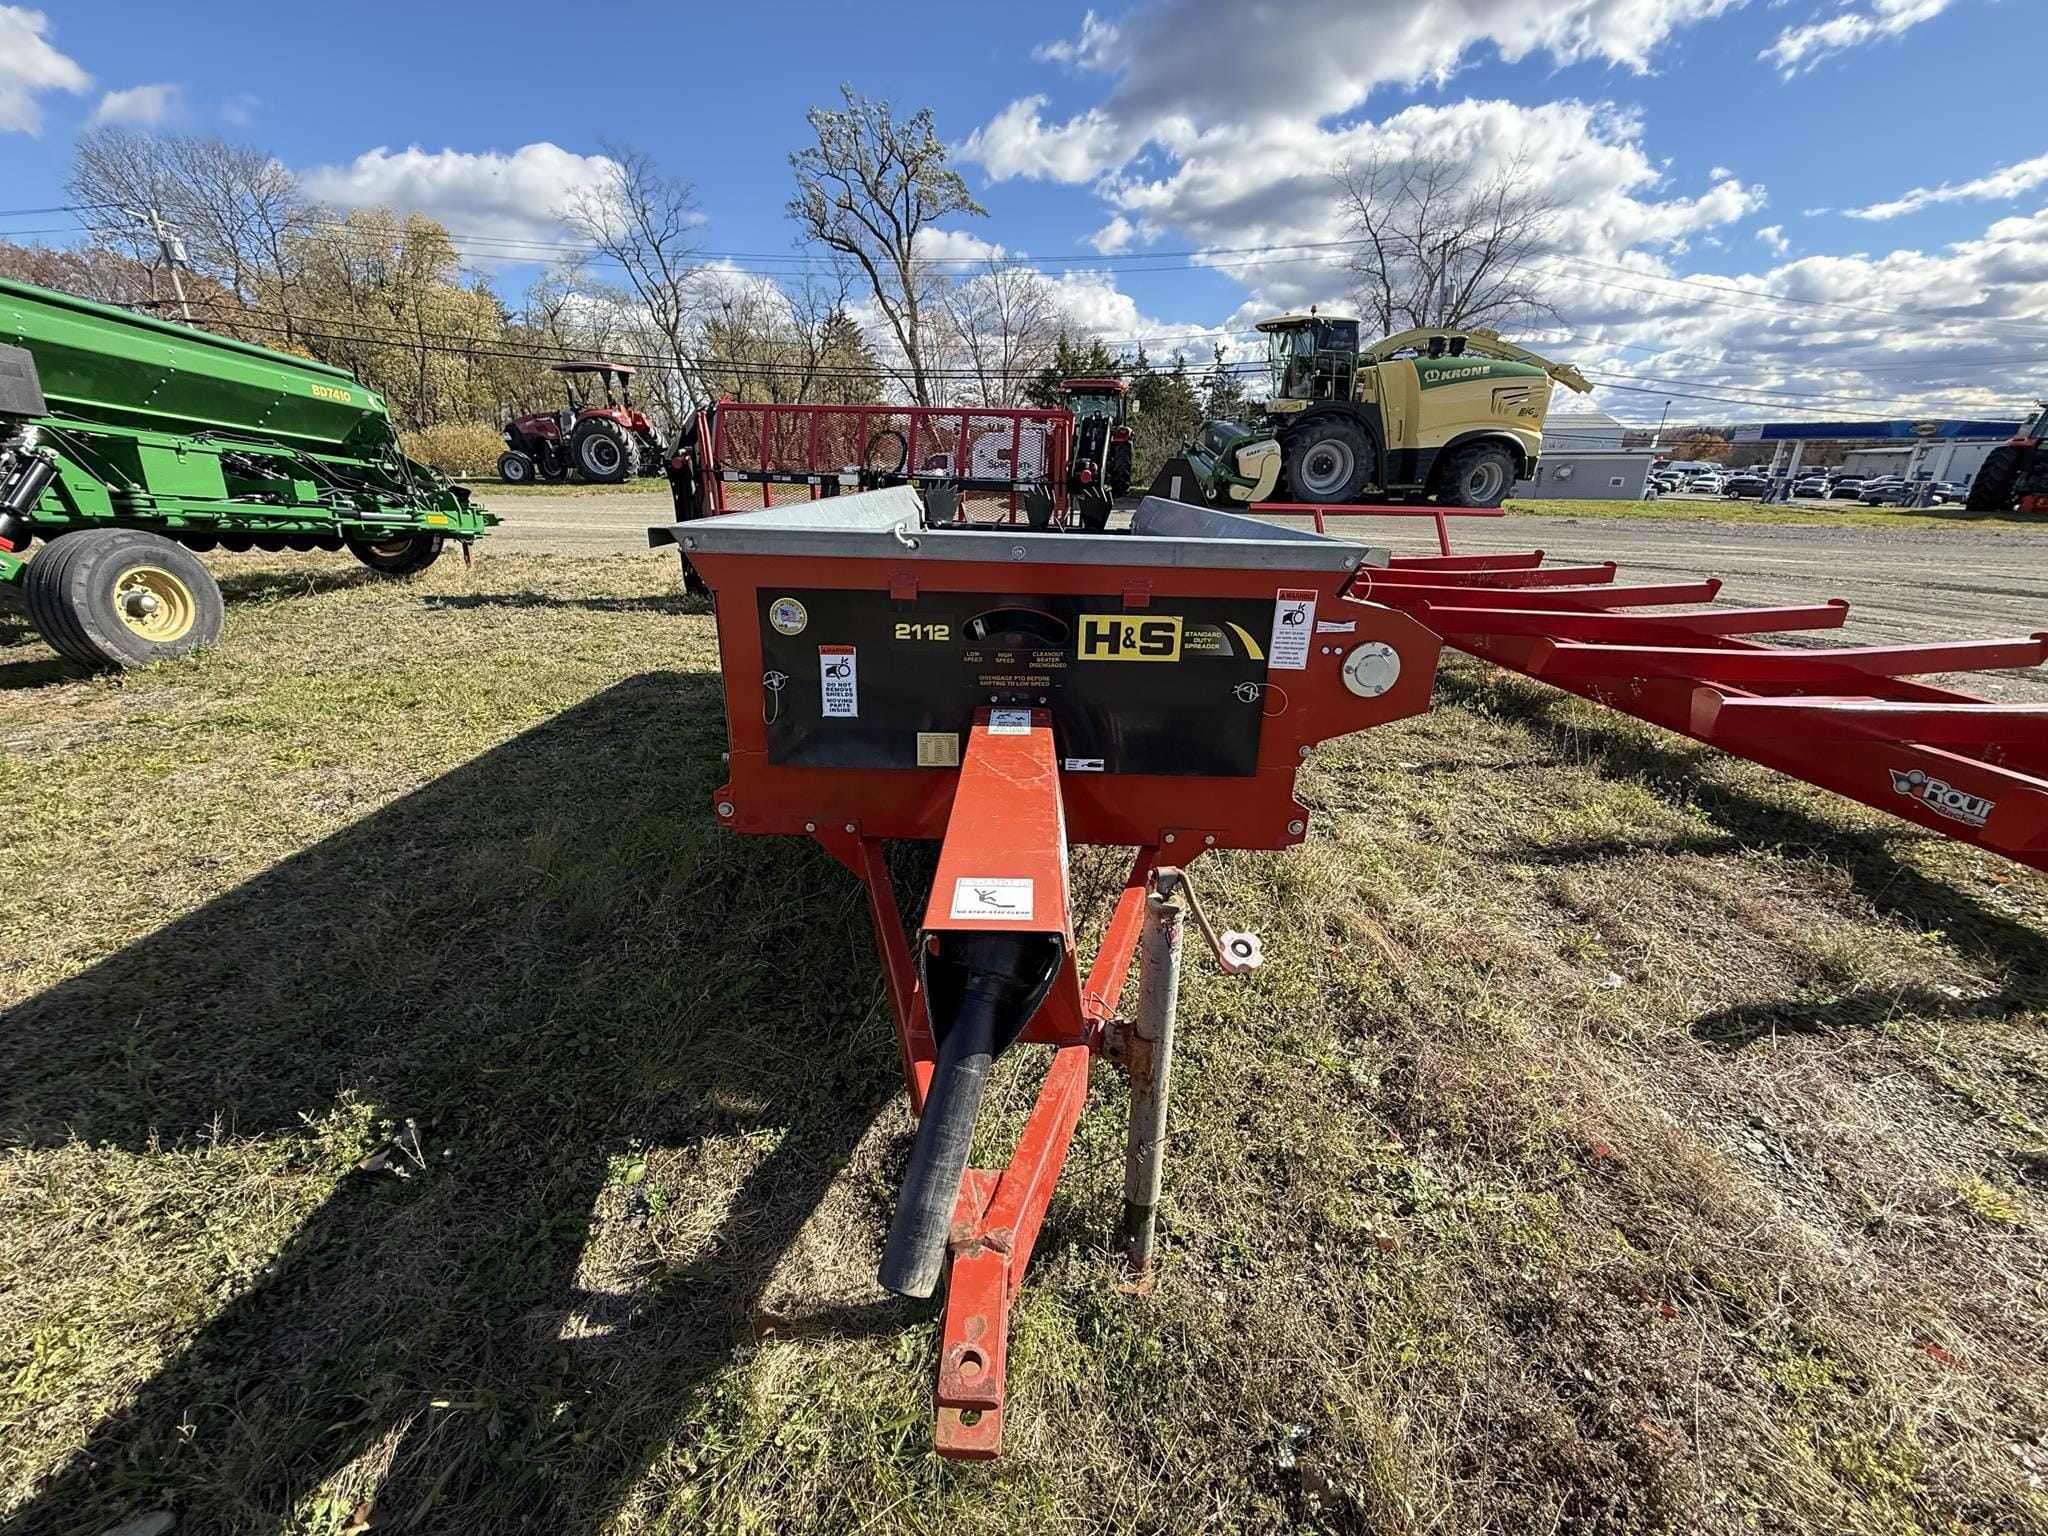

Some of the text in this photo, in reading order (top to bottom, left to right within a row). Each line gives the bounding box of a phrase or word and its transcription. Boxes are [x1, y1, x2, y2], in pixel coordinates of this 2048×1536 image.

[1440, 365, 1491, 381] KRONE
[311, 384, 352, 402] BD7410
[1286, 591, 1314, 600] WARNING
[895, 623, 950, 641] 2112
[1085, 621, 1176, 656] H&S
